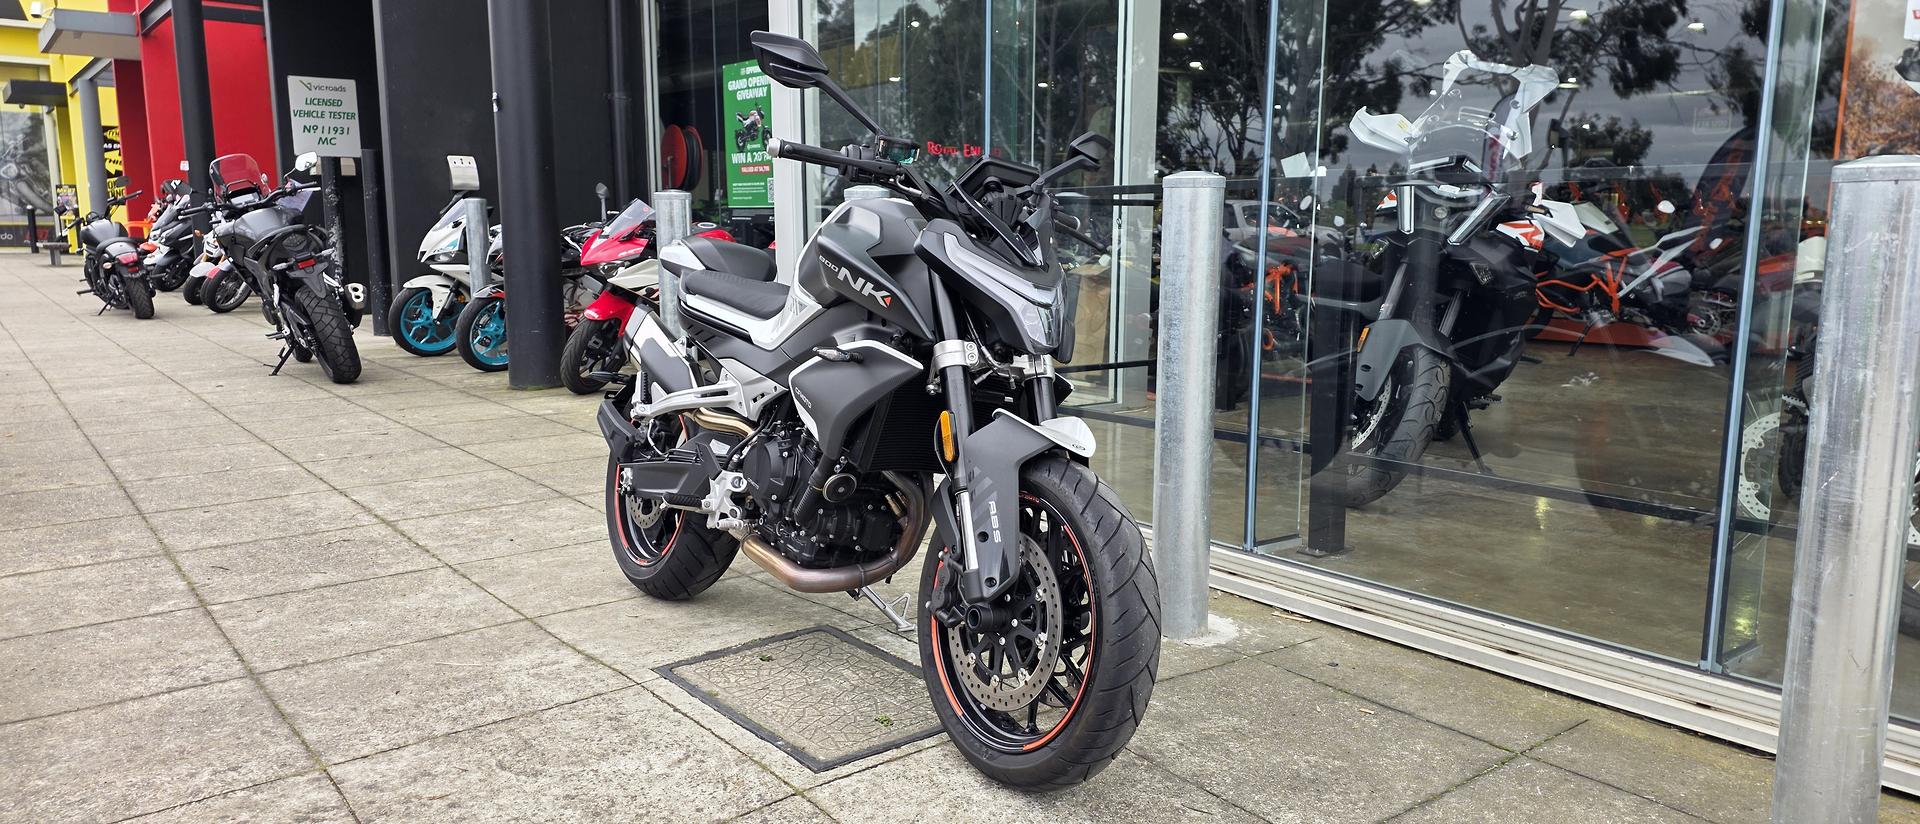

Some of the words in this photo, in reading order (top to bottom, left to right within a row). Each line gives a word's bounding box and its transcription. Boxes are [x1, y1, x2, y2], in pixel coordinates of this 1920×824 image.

[728, 79, 748, 91] GRAND
[736, 87, 768, 100] GIVEAWAY
[305, 97, 343, 107] LICENSED
[293, 109, 326, 119] VEHICLE
[328, 111, 356, 120] TESTER
[321, 126, 350, 135] 11931
[317, 137, 337, 146] MC
[731, 152, 746, 164] WIN
[747, 152, 753, 163] A
[837, 266, 892, 308] NK
[988, 500, 1002, 543] ABS
